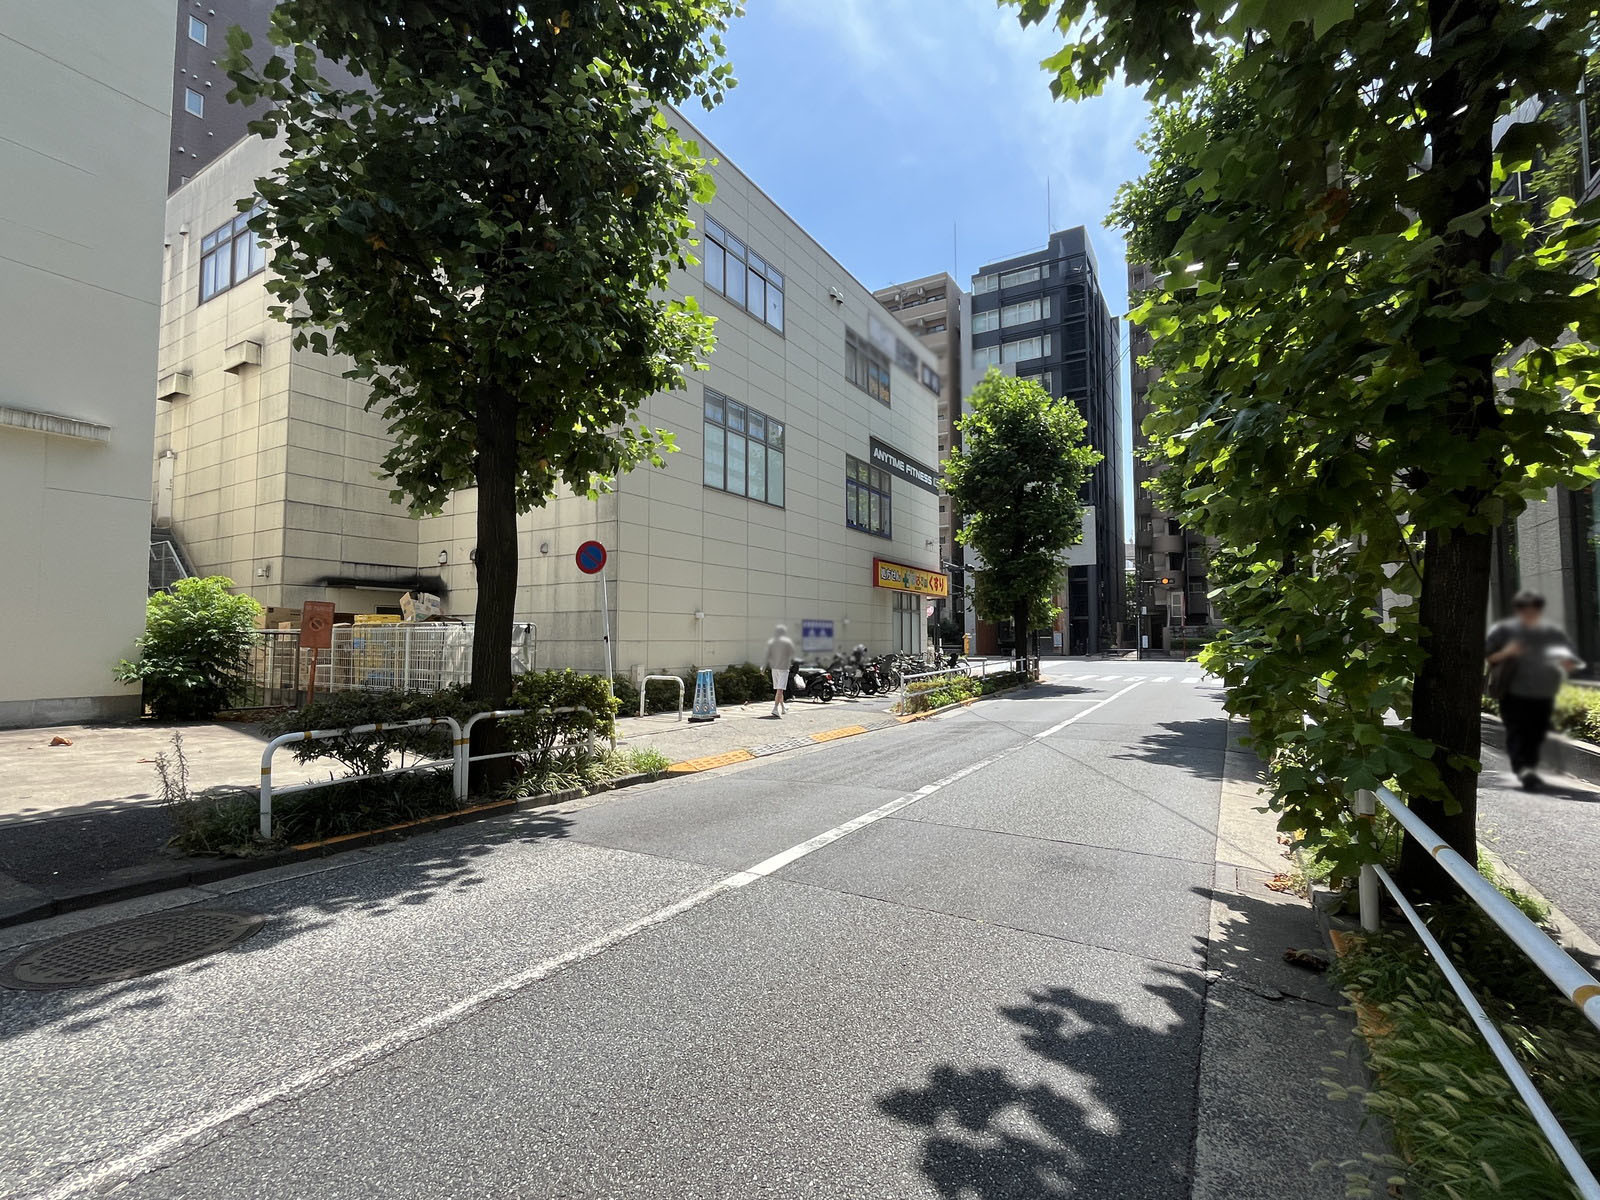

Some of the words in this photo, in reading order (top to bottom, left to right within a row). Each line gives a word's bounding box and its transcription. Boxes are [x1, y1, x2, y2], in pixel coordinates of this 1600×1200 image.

[873, 447, 905, 472] ANYTIME
[905, 464, 933, 486] FITNESS
[928, 575, 945, 593] くすり
